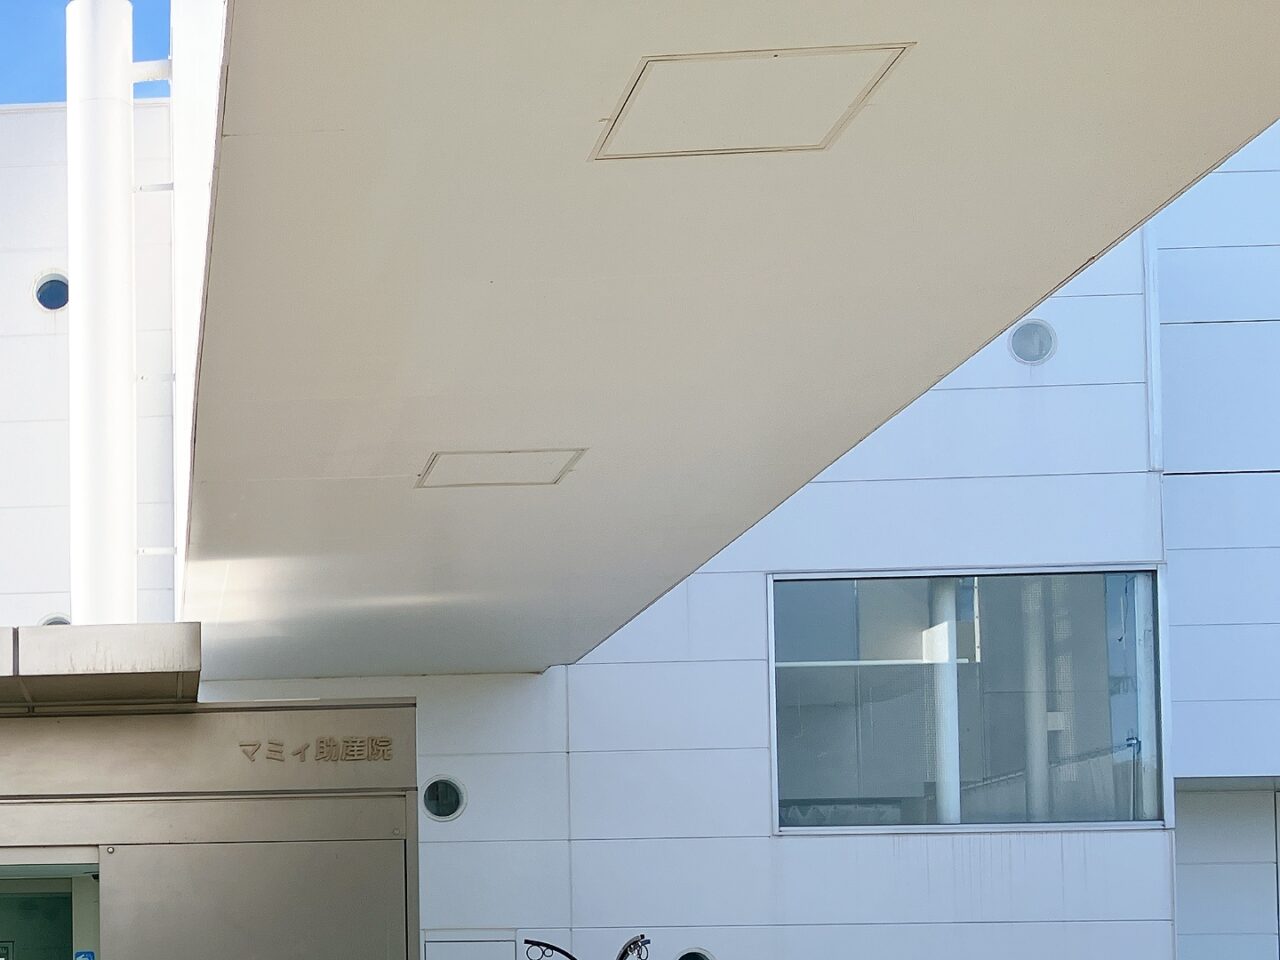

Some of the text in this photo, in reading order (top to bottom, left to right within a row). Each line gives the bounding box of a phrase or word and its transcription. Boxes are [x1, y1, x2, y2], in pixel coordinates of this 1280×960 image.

[239, 736, 393, 762] マミィ助産院
